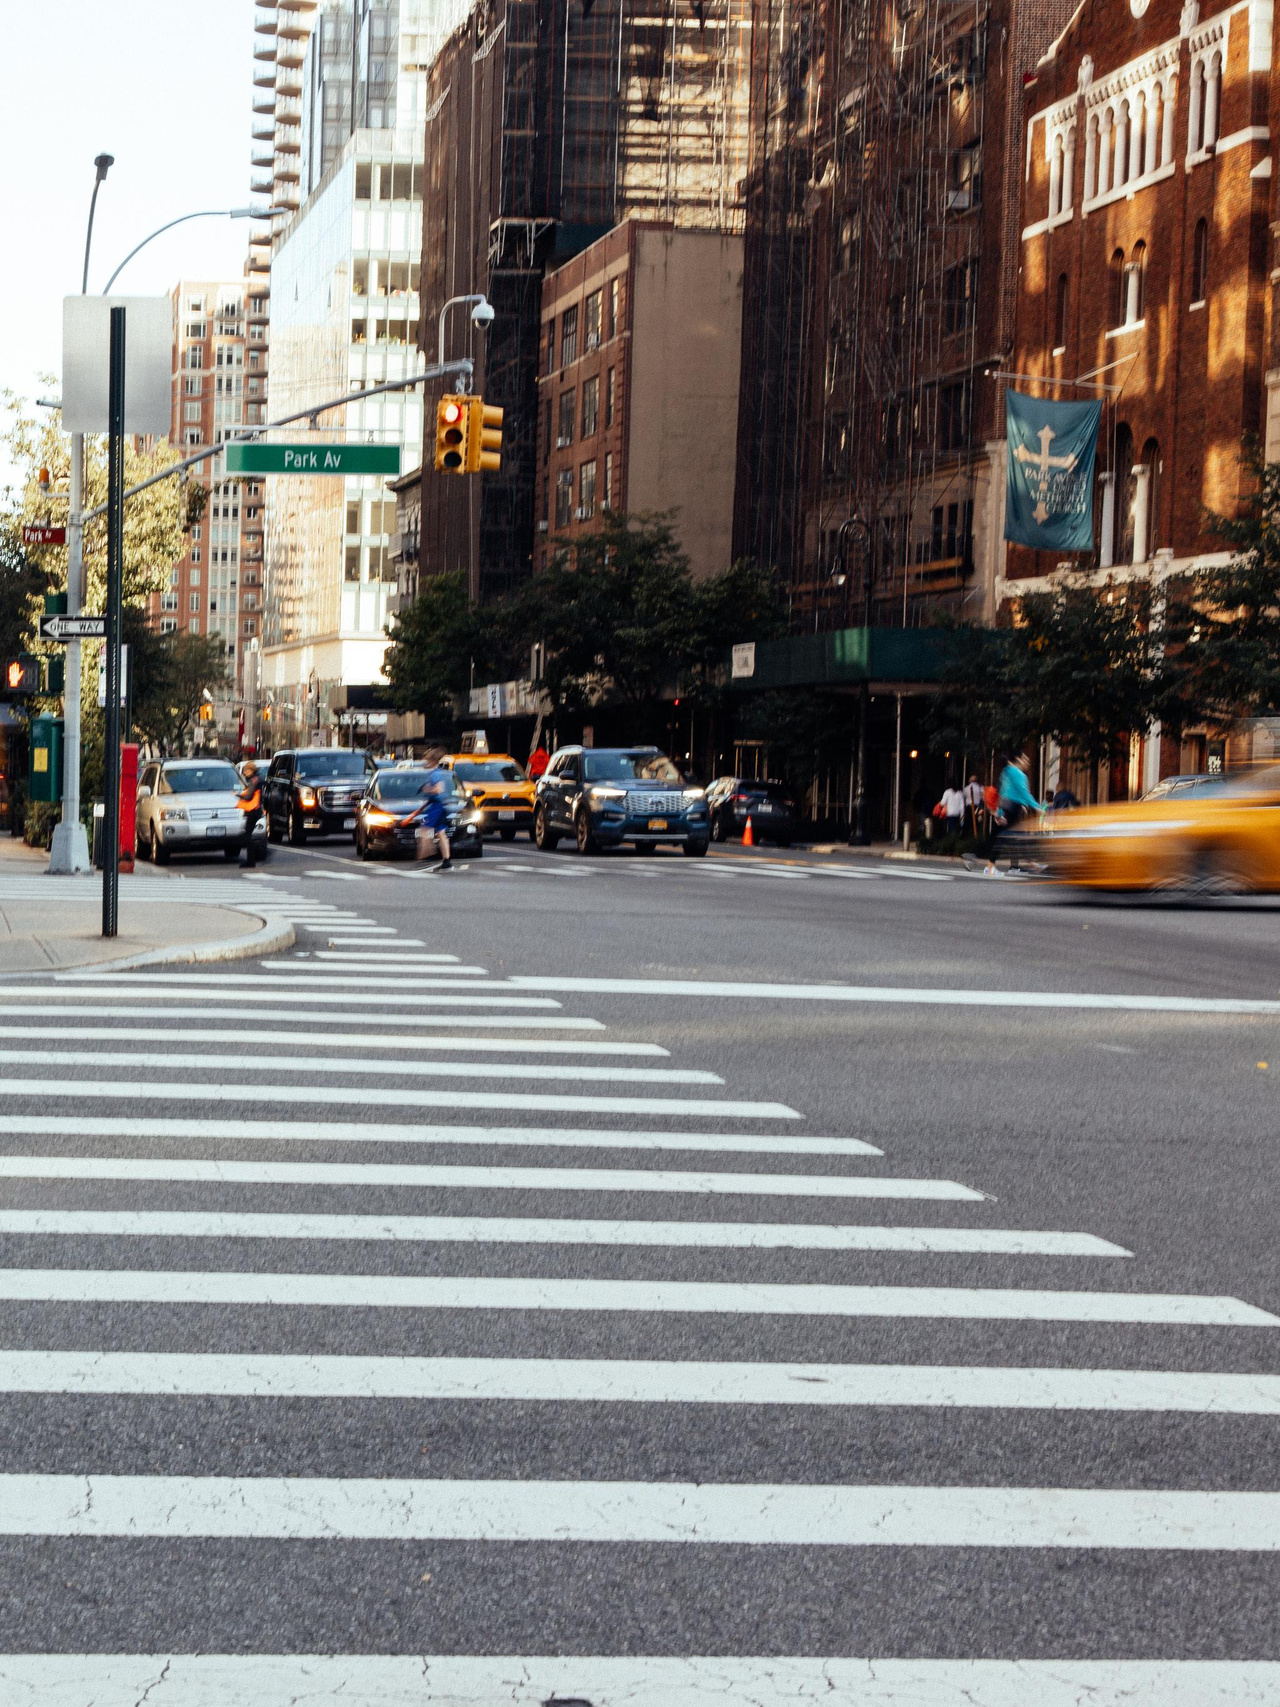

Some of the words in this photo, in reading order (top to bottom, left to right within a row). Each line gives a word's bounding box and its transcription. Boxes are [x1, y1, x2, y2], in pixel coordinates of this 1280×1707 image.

[285, 450, 318, 468] Park
[323, 451, 341, 468] Av
[1025, 467, 1051, 483] PARK
[25, 529, 43, 542] Park
[50, 621, 70, 633] ONE
[79, 621, 100, 633] WAY
